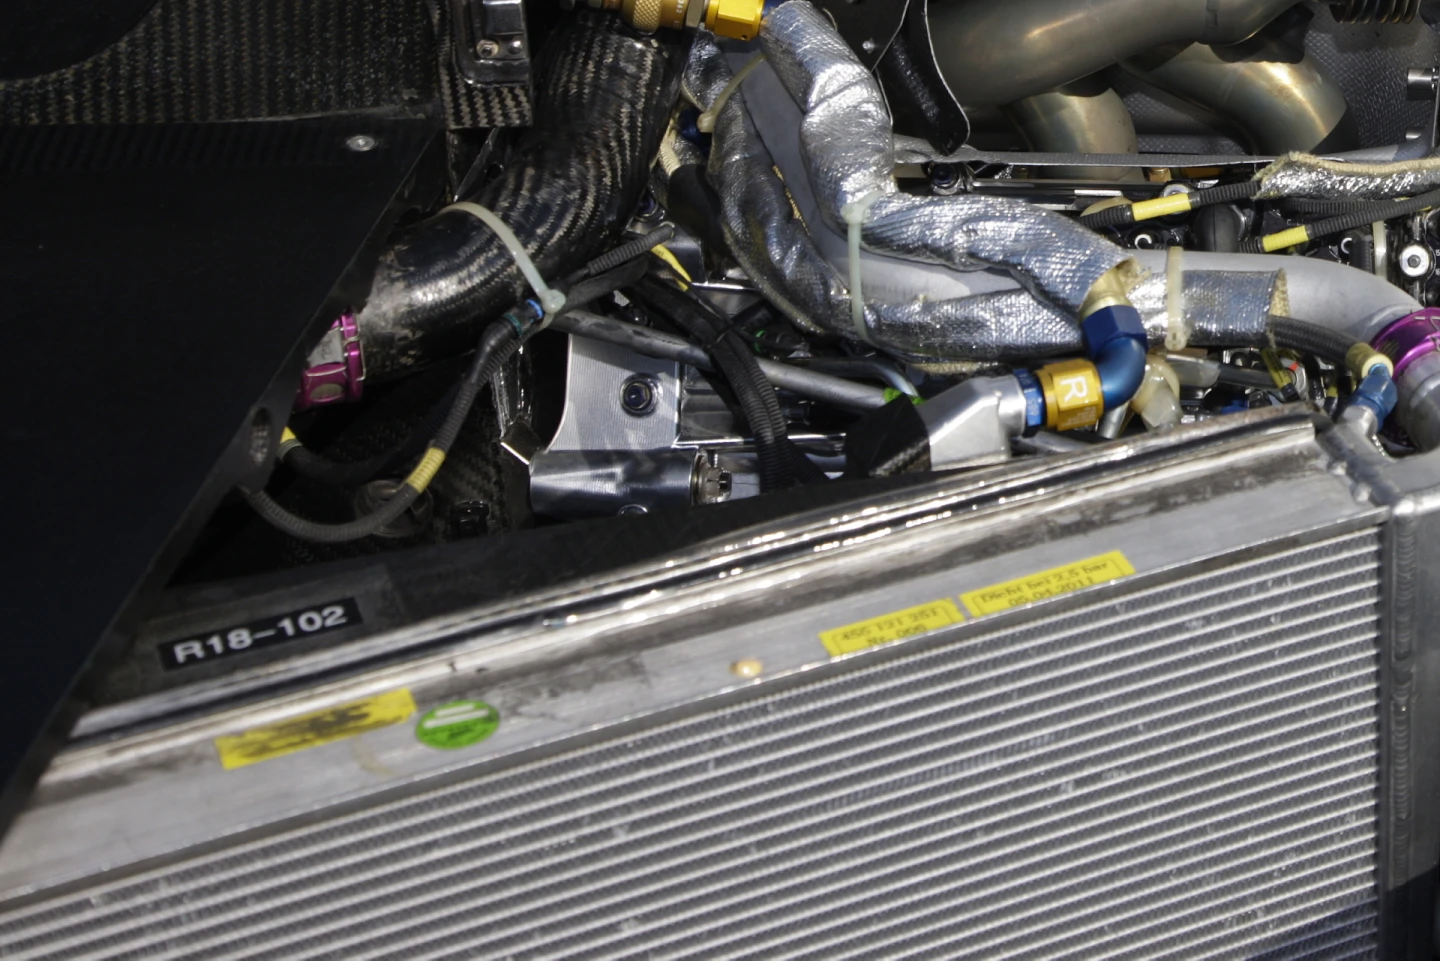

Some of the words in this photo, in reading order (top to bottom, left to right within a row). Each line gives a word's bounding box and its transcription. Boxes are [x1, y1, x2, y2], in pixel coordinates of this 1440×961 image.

[1061, 375, 1088, 403] R
[1082, 561, 1108, 574] bar
[173, 604, 349, 665] R18-102
